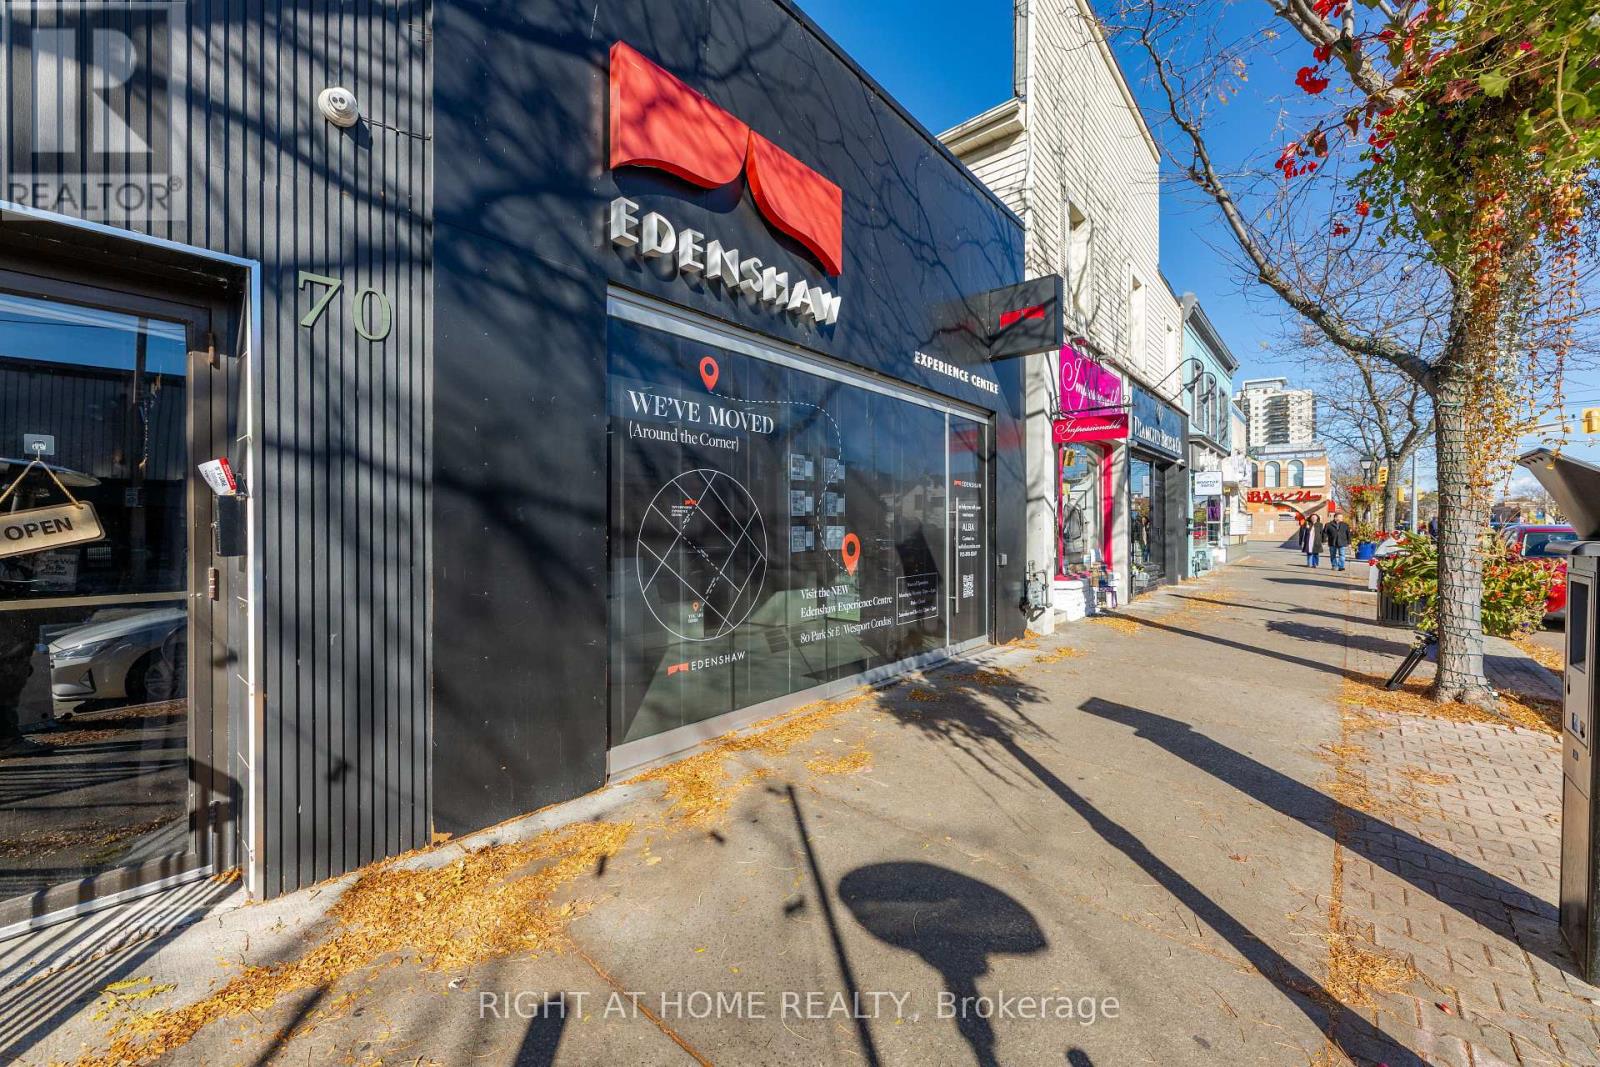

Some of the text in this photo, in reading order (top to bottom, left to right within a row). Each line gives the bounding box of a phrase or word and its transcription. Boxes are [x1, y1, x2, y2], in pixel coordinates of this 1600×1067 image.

[610, 196, 842, 325] EDENSHAW
[298, 270, 392, 342] 70
[913, 351, 1000, 395] EXPERIENCE CENTRE
[627, 389, 774, 434] WE'VE MOVED
[1055, 411, 1125, 440] Impressionable
[629, 420, 739, 452] (Around the Corner)
[4, 517, 73, 540] OPEN
[800, 584, 850, 600] Visit the NEW
[800, 596, 893, 619] Edenshaw Experience Centre
[800, 632, 810, 644] 80
[811, 629, 826, 641] Park
[835, 626, 841, 636] E
[691, 650, 746, 671] EDENSHAW
